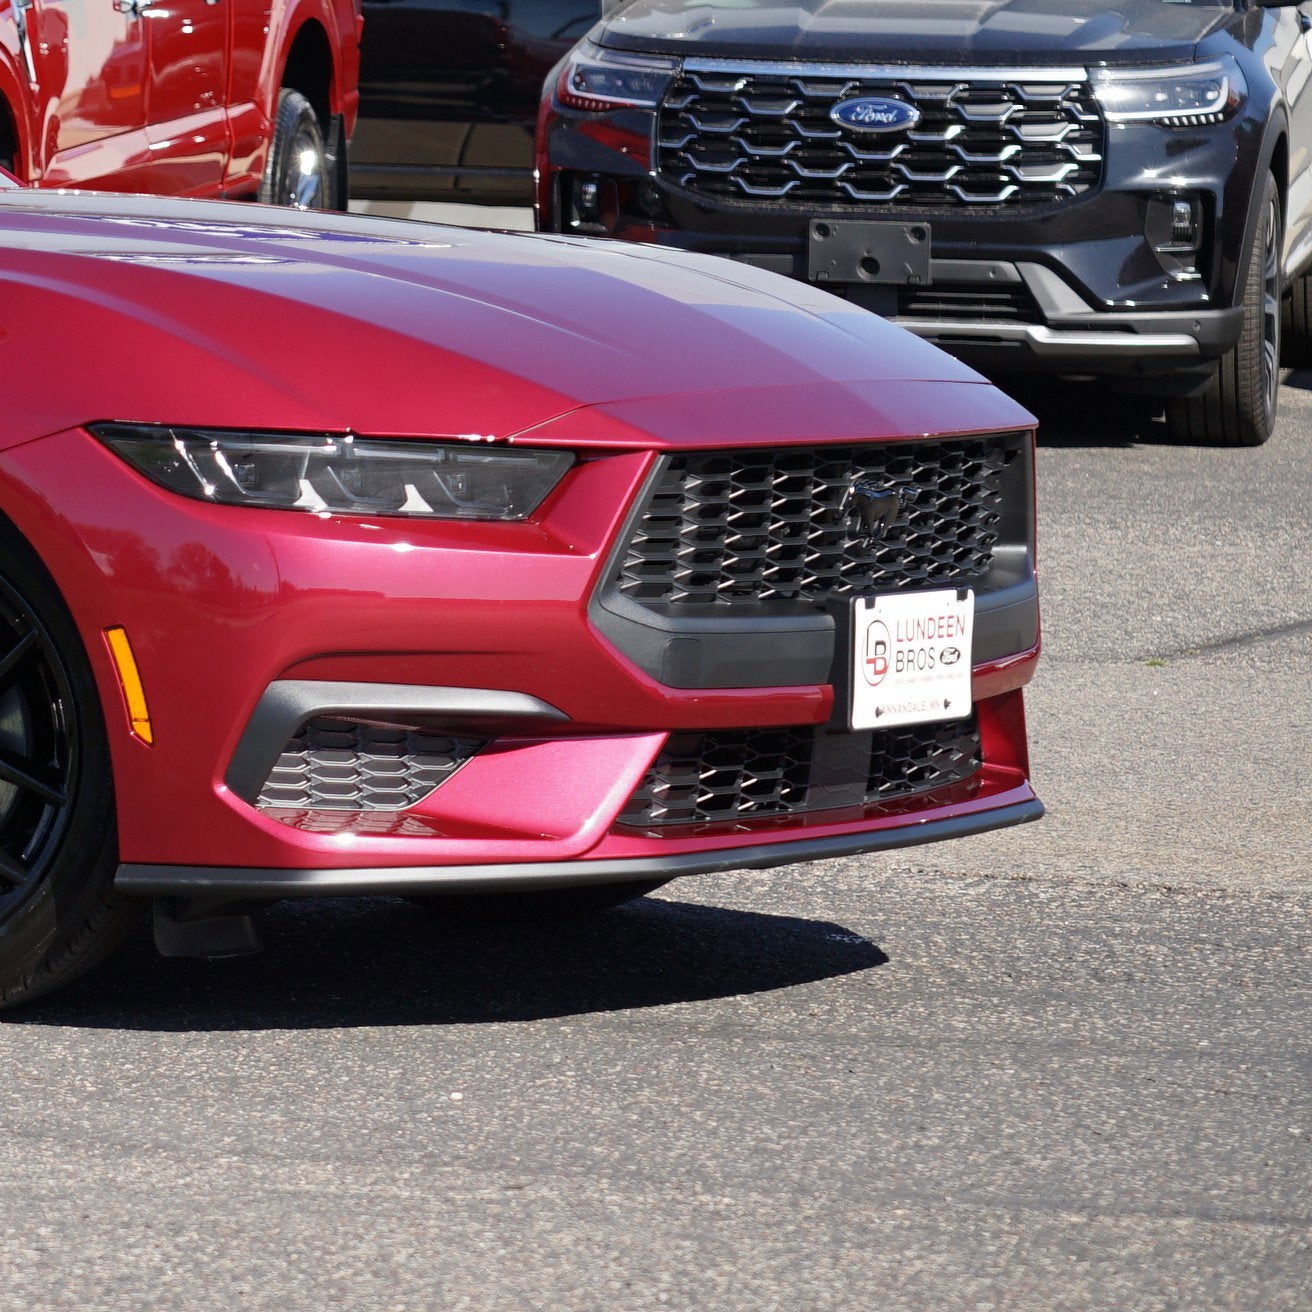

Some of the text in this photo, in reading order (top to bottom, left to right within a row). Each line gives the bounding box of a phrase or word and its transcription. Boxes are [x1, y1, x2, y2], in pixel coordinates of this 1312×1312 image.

[850, 103, 897, 124] Ford
[896, 614, 966, 642] LUNDEEN
[895, 646, 936, 673] BROS
